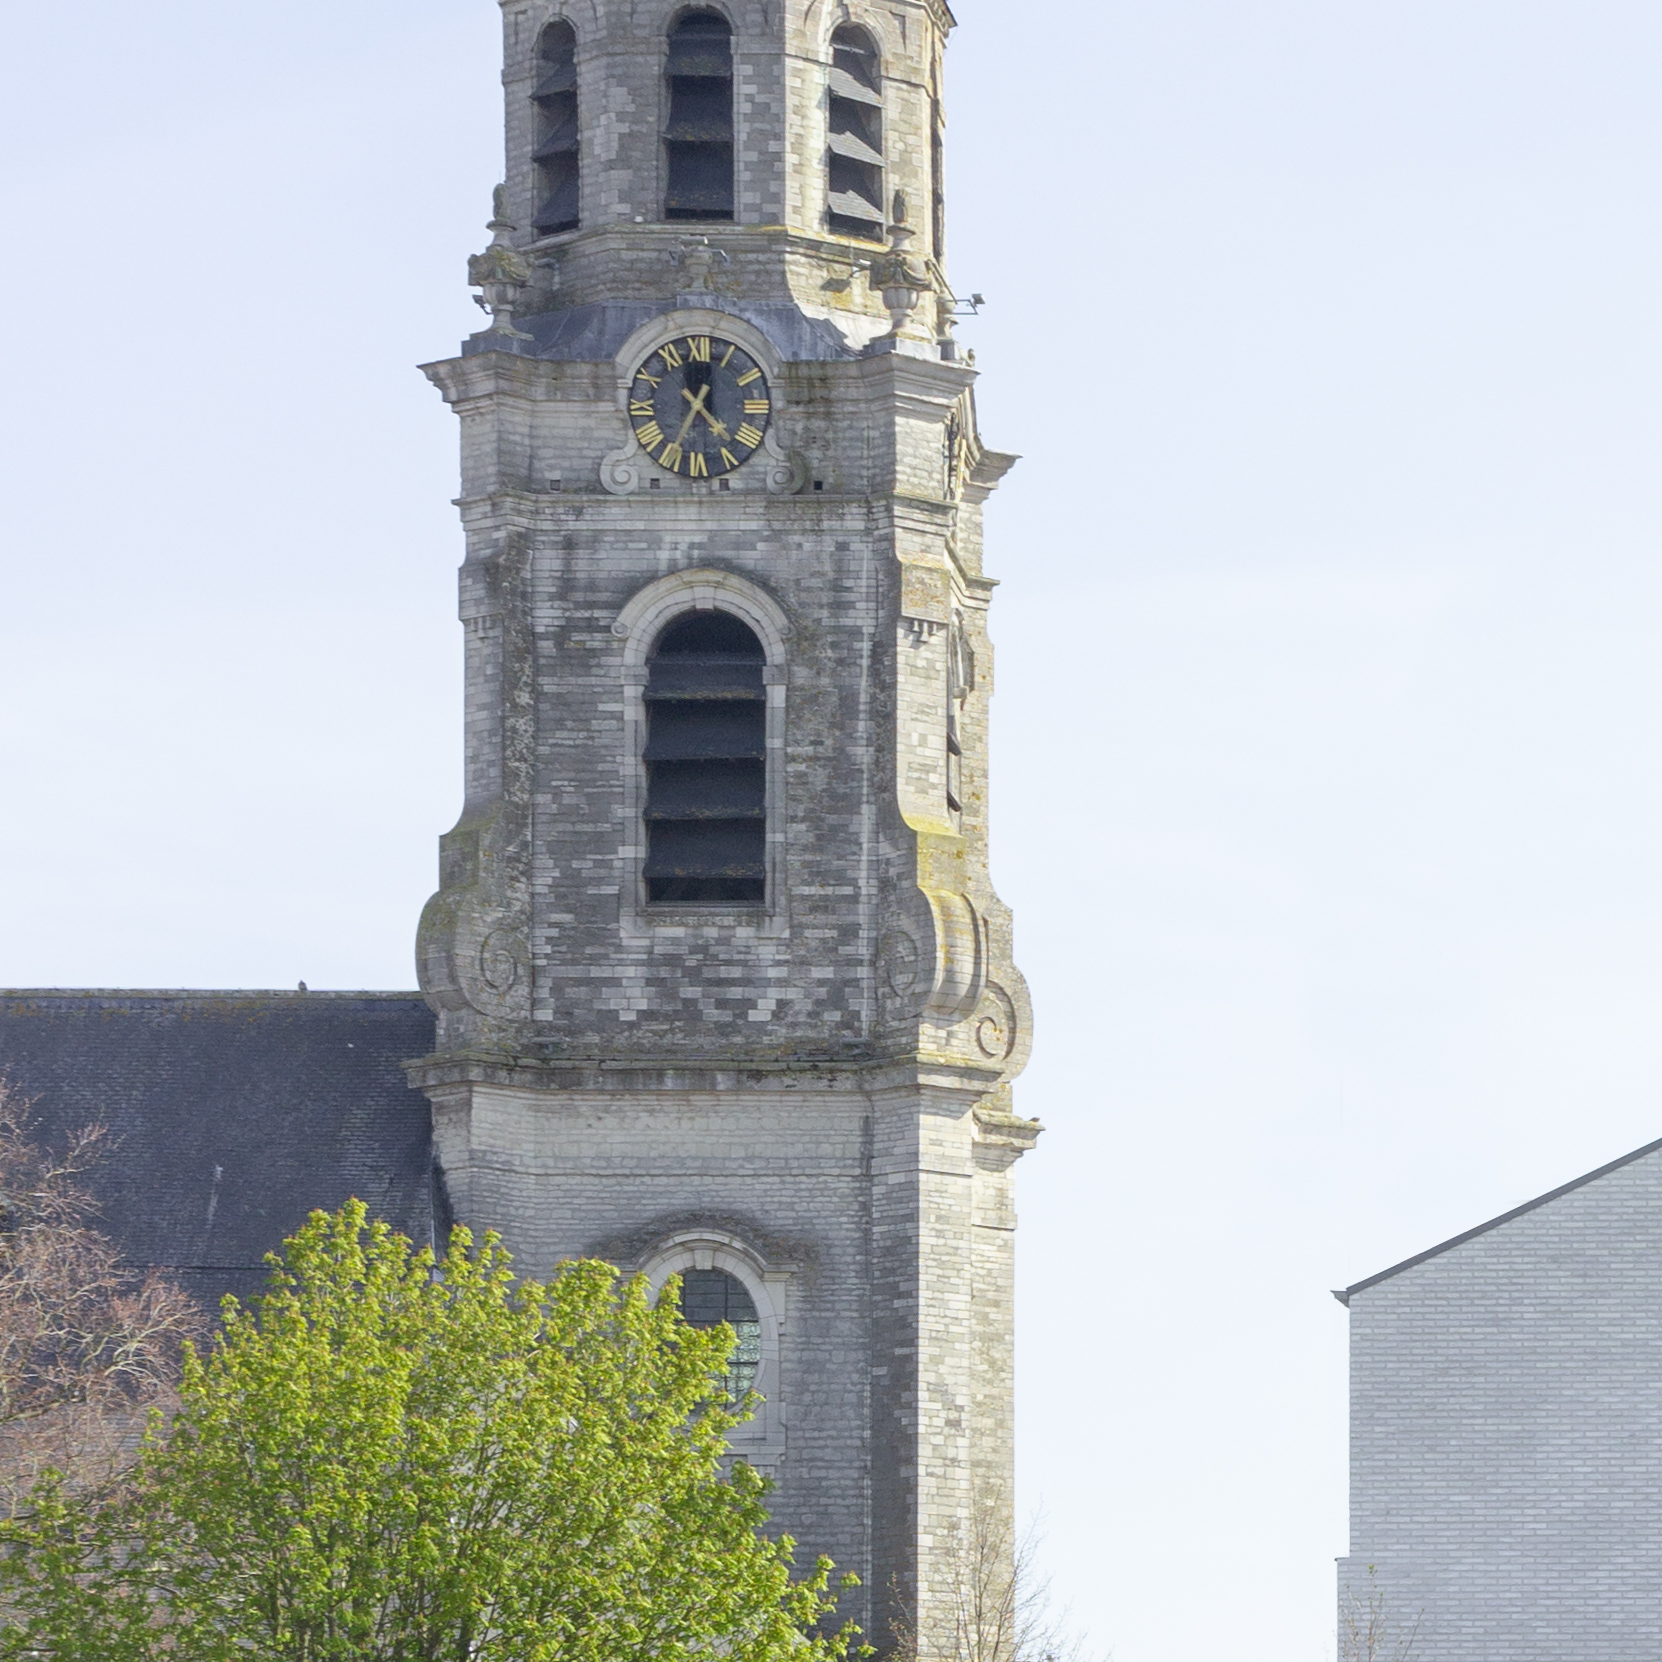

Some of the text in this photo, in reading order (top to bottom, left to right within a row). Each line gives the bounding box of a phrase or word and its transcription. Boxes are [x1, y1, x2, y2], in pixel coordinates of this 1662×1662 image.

[658, 343, 683, 371] XI
[687, 337, 710, 362] XII
[720, 345, 736, 368] I
[636, 367, 662, 388] X
[737, 367, 762, 387] II
[630, 399, 655, 416] IX
[744, 399, 769, 415] III
[635, 420, 664, 453] VIII
[690, 451, 708, 477] VI
[720, 446, 739, 470] V
